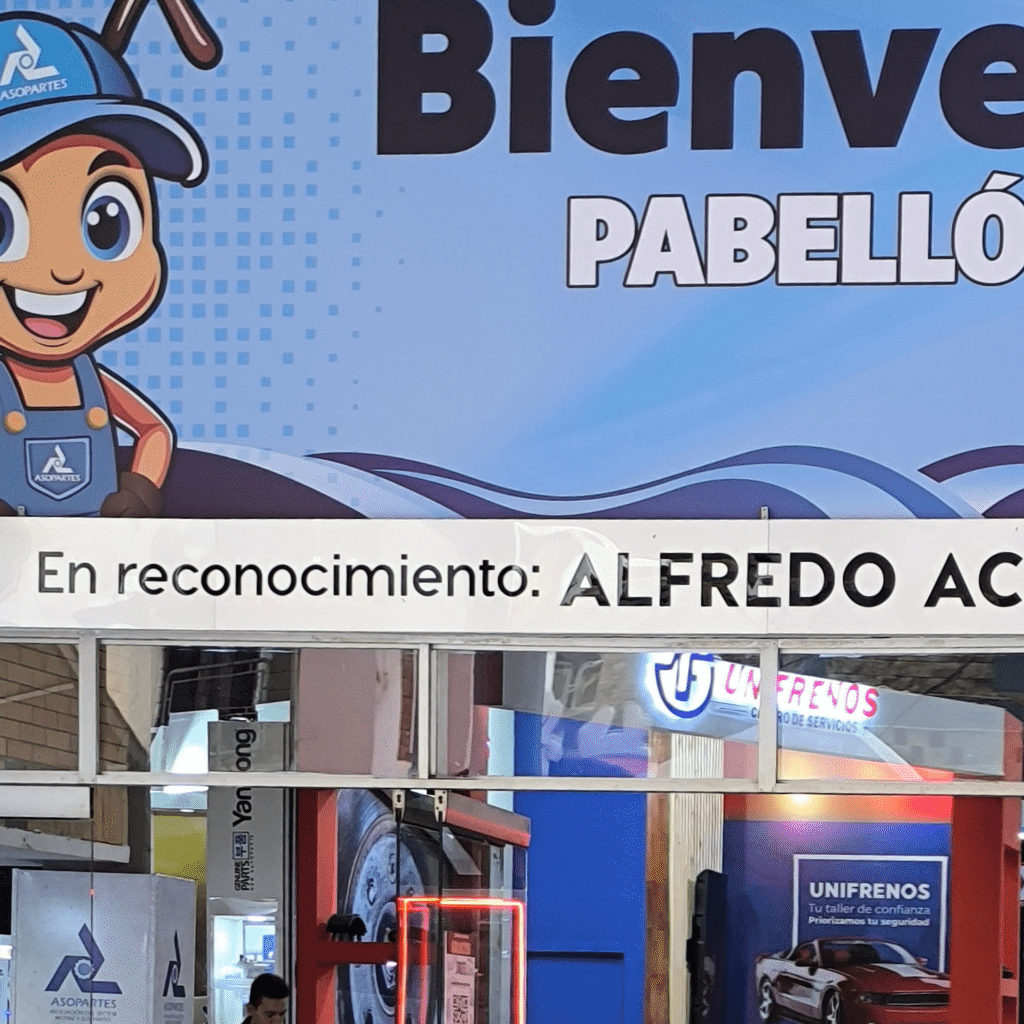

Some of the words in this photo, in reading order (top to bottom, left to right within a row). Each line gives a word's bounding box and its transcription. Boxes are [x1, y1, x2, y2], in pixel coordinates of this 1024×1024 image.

[0, 78, 68, 101] ASOPARTES
[37, 551, 97, 595] En
[118, 553, 541, 597] reconocimiento:
[559, 551, 896, 608] ALFREDO
[724, 662, 880, 718] UNFRENOS
[232, 728, 257, 827] Yanong
[241, 861, 250, 891] PARTS
[809, 882, 931, 900] UNIFRENOS
[809, 903, 823, 913] Tu
[825, 904, 855, 914] taller
[857, 904, 872, 914] de
[875, 904, 931, 915] confianza
[808, 916, 866, 925] Priorizamos
[868, 917, 879, 925] tu
[881, 918, 930, 928] seguridad
[50, 997, 117, 1009] ASOPARTES
